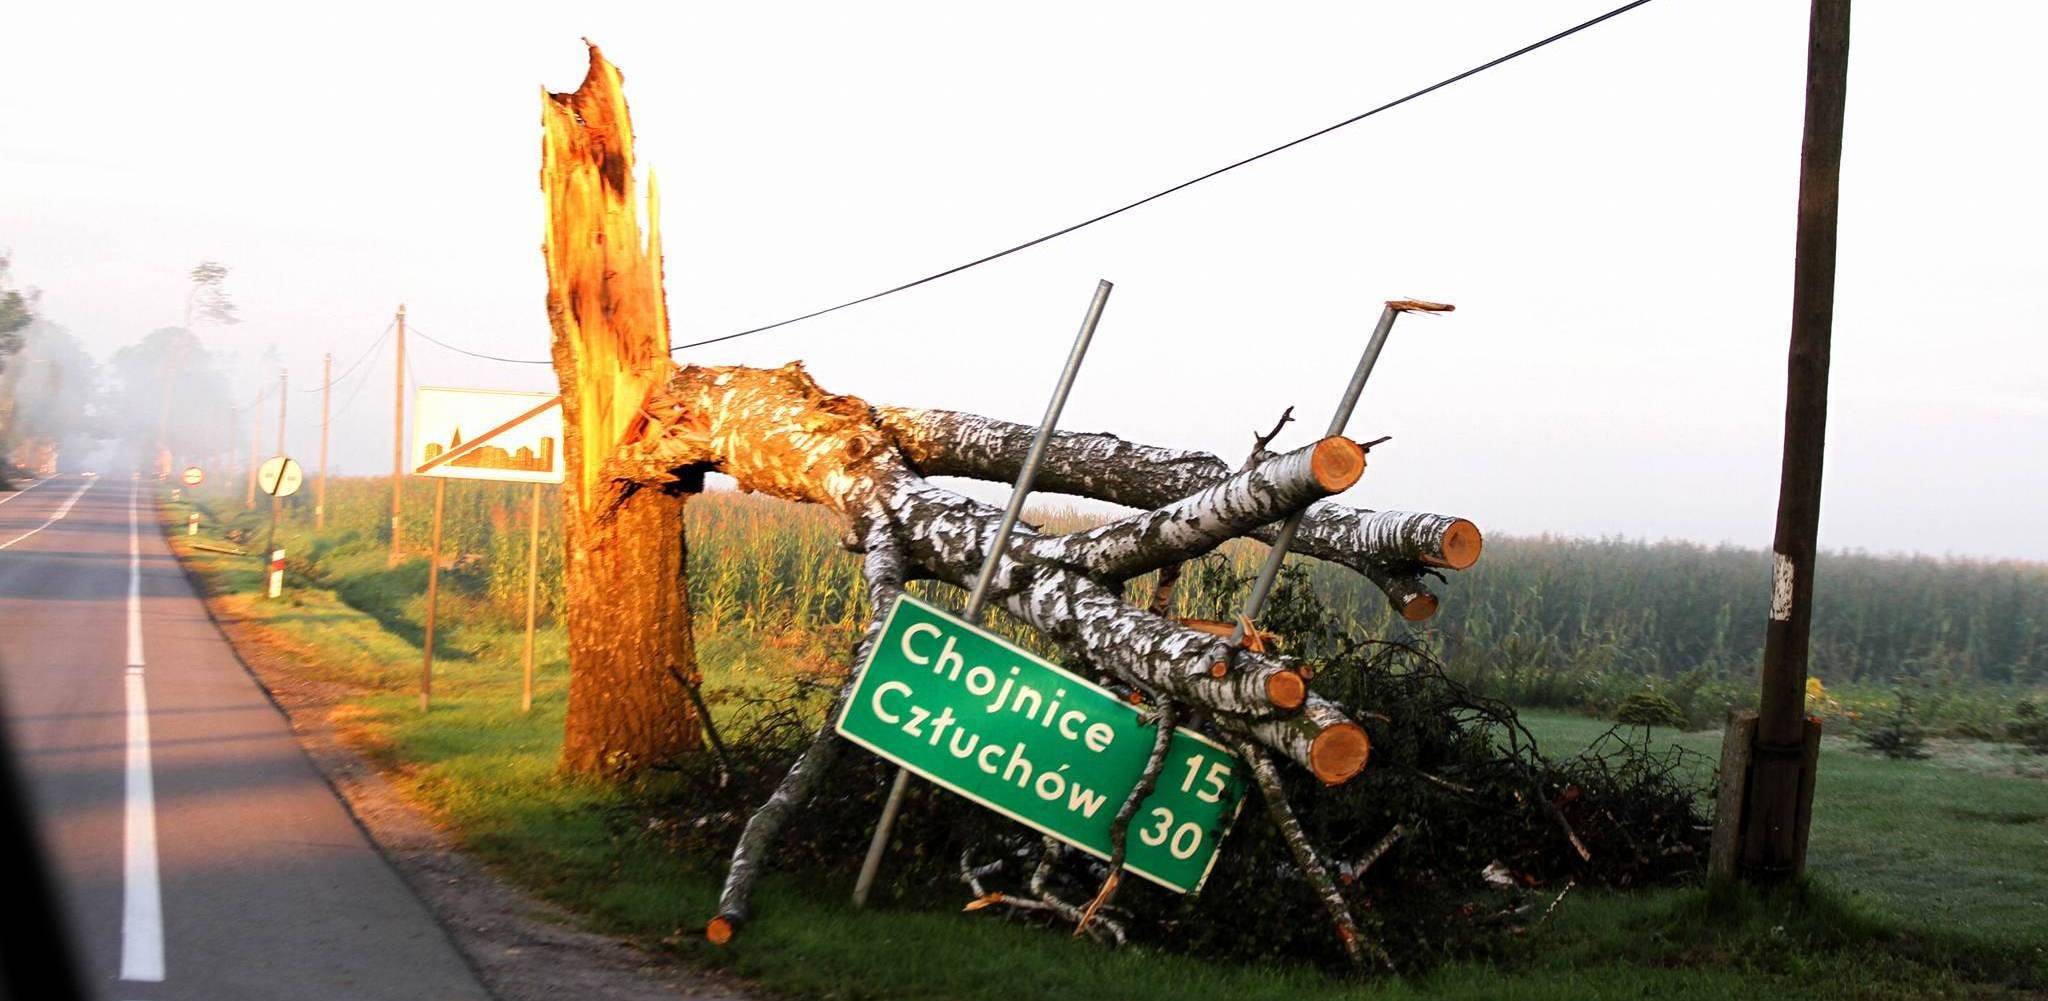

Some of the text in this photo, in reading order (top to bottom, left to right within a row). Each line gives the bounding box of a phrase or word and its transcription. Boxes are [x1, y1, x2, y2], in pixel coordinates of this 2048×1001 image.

[871, 681, 1203, 860] Człuchów 30
[901, 623, 1231, 803] Chojnice 15
